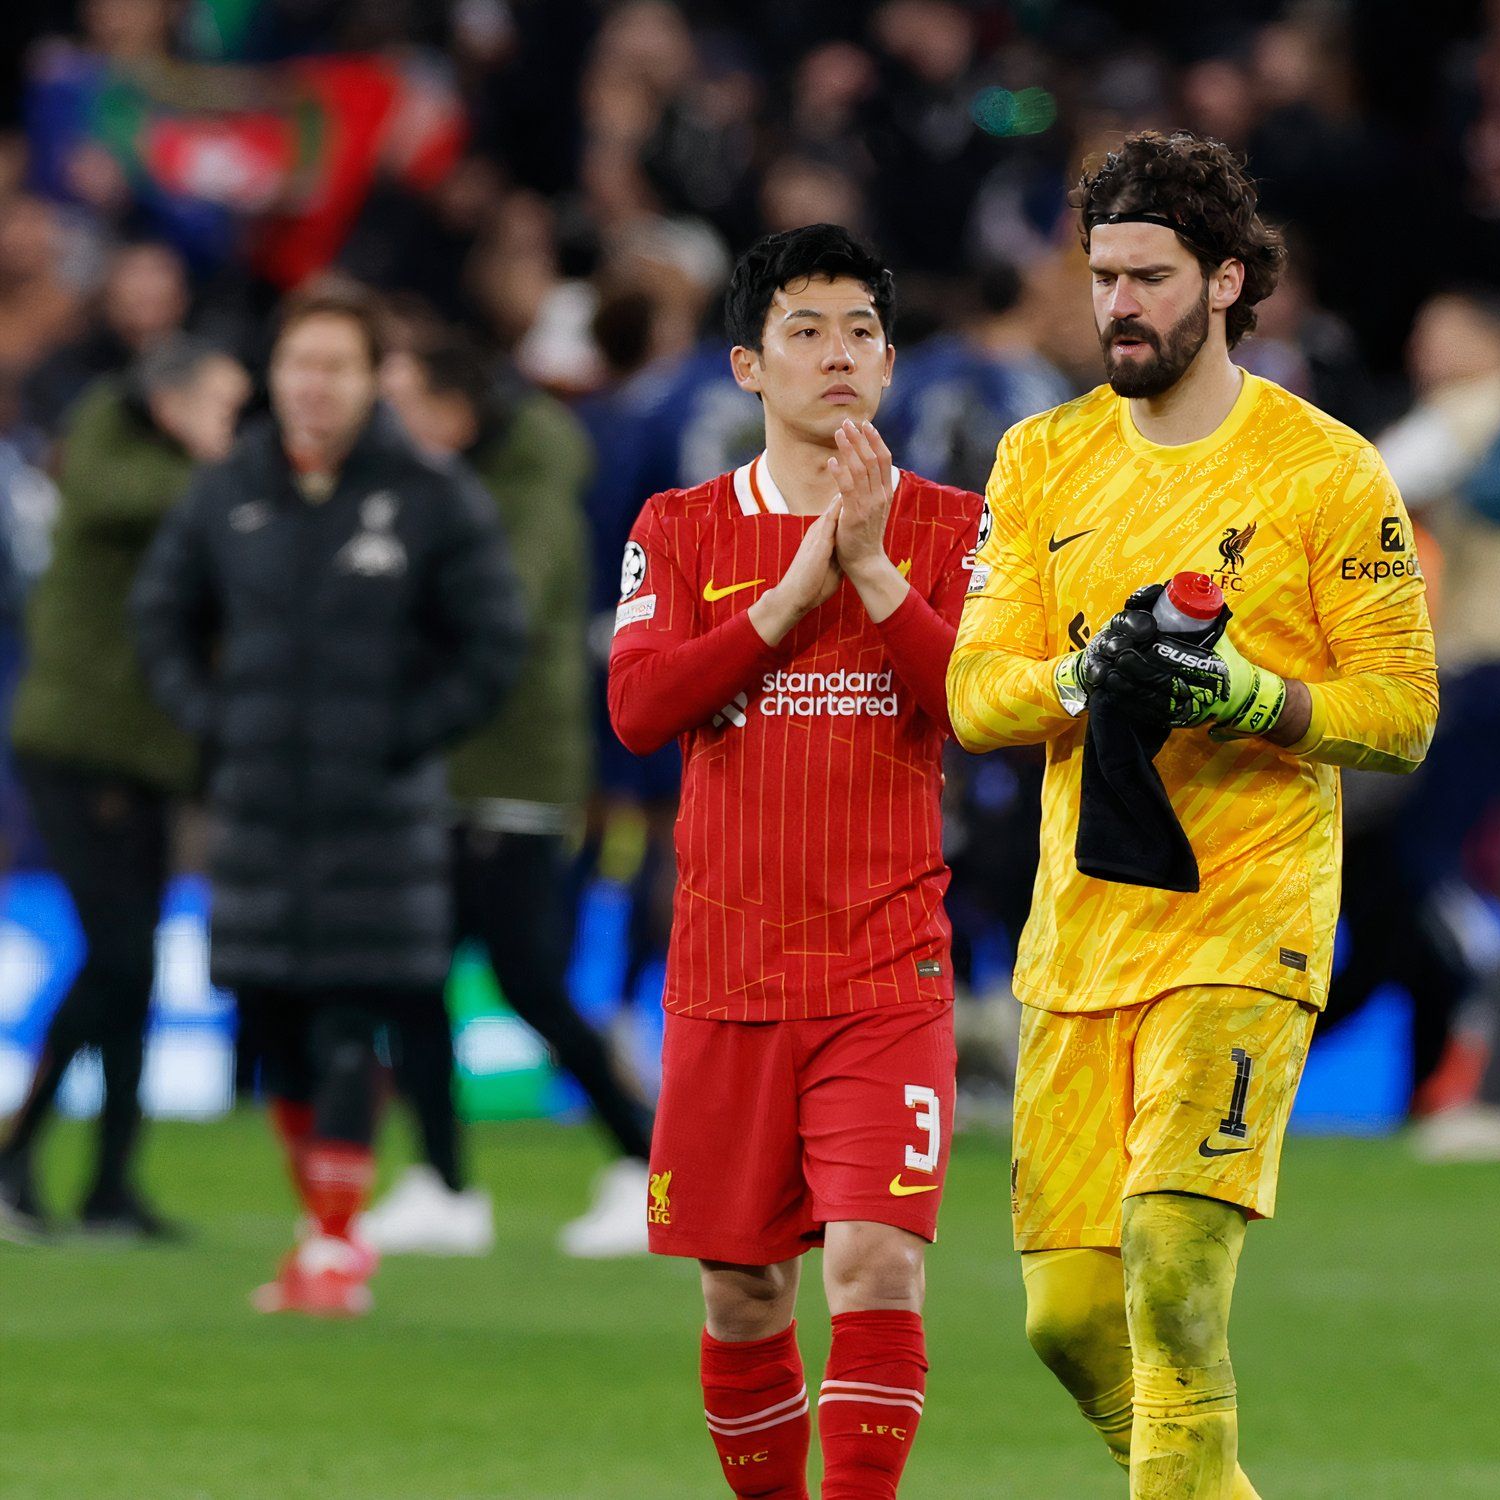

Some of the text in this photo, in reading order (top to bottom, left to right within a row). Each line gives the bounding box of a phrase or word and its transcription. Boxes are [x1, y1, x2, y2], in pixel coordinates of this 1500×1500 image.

[762, 668, 892, 692] standard
[760, 692, 898, 716] chartered
[1218, 1047, 1252, 1140] 1
[904, 1084, 940, 1175] 3
[860, 1423, 907, 1441] LFC
[726, 1450, 769, 1466] LFC
